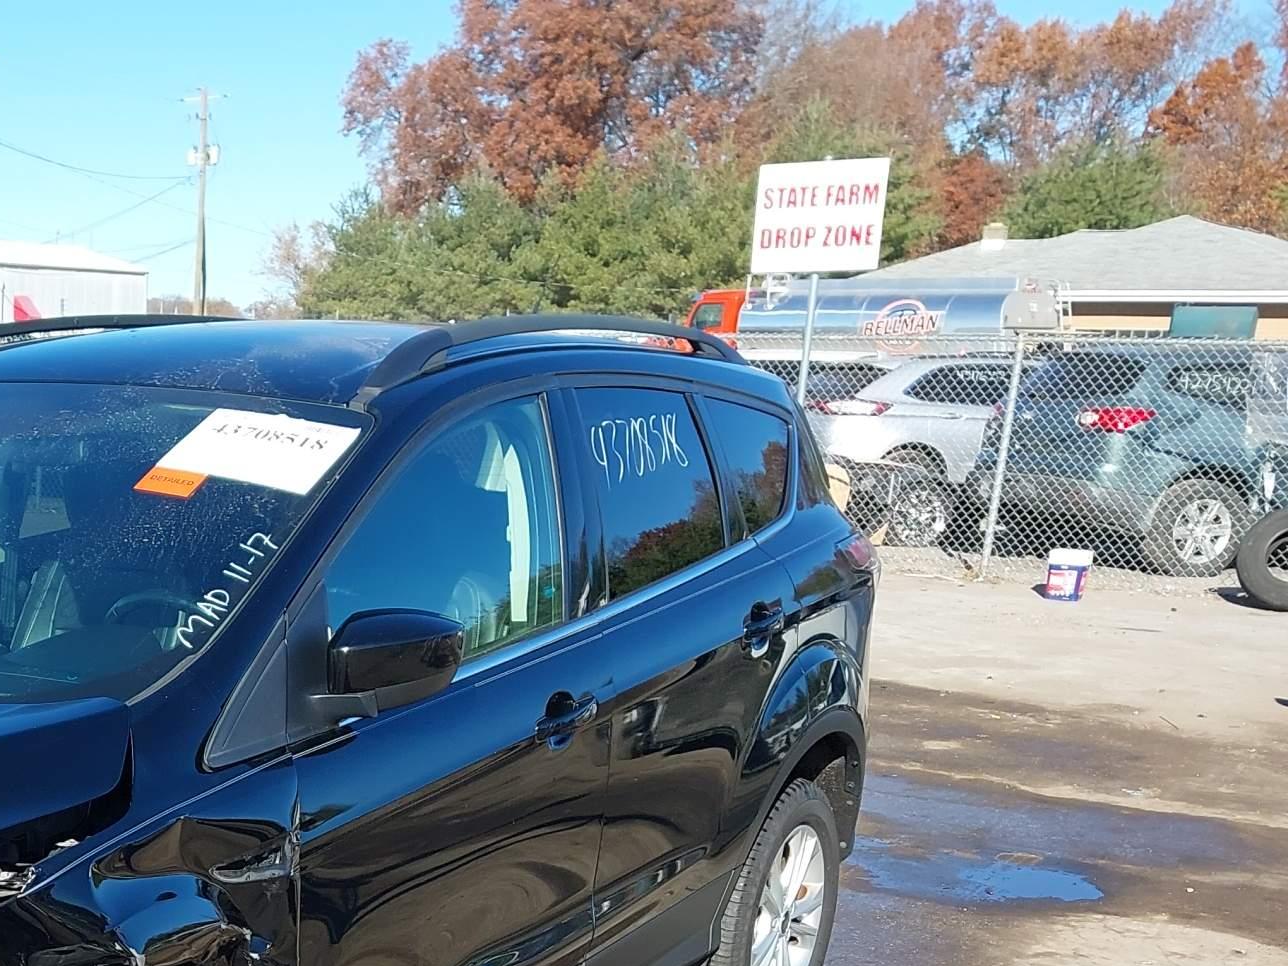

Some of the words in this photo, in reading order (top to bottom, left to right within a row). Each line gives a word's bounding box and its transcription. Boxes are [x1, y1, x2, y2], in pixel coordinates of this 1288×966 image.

[763, 185, 819, 209] STATE
[826, 183, 879, 206] FARM
[760, 227, 816, 249] DROP
[822, 224, 874, 247] ZONE
[212, 423, 328, 450] 43708518
[591, 413, 688, 489] 43708518
[177, 589, 230, 648] MAD
[223, 532, 279, 582] 11-17
